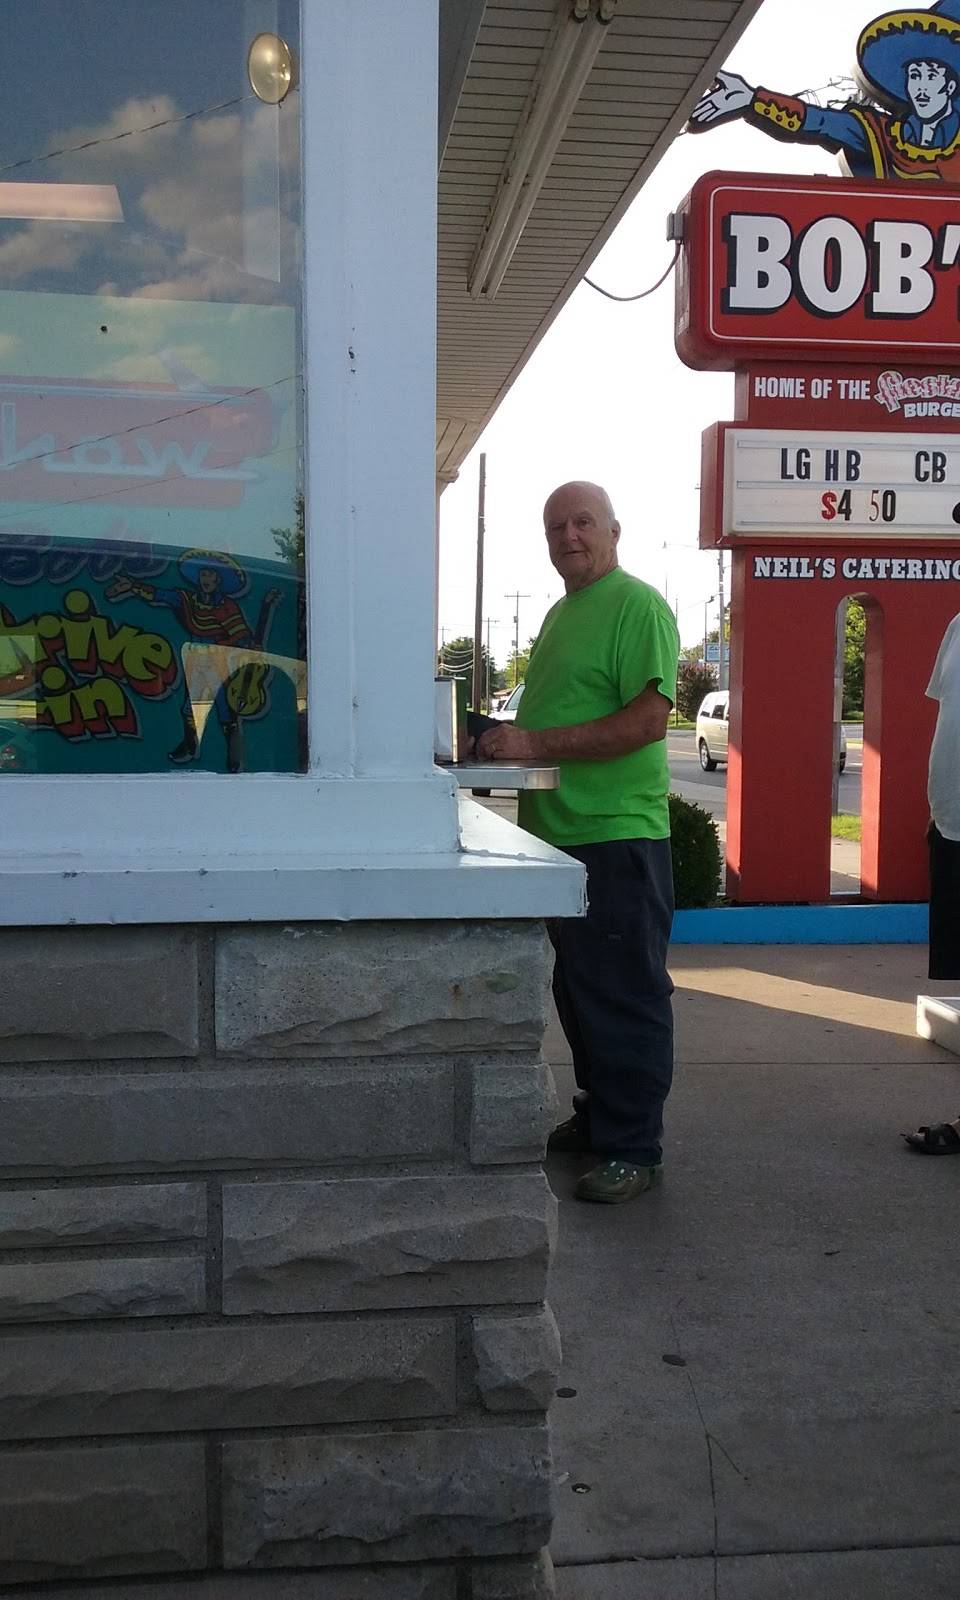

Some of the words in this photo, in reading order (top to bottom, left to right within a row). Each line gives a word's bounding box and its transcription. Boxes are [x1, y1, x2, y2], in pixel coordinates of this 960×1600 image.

[755, 377, 805, 398] HOME
[811, 378, 832, 398] OF
[837, 379, 870, 399] THE
[781, 448, 811, 480] LG
[825, 450, 861, 481] HB
[915, 451, 947, 483] CB
[754, 556, 836, 579] NEIL'S
[0, 591, 176, 690] rive
[36, 665, 135, 733] in
